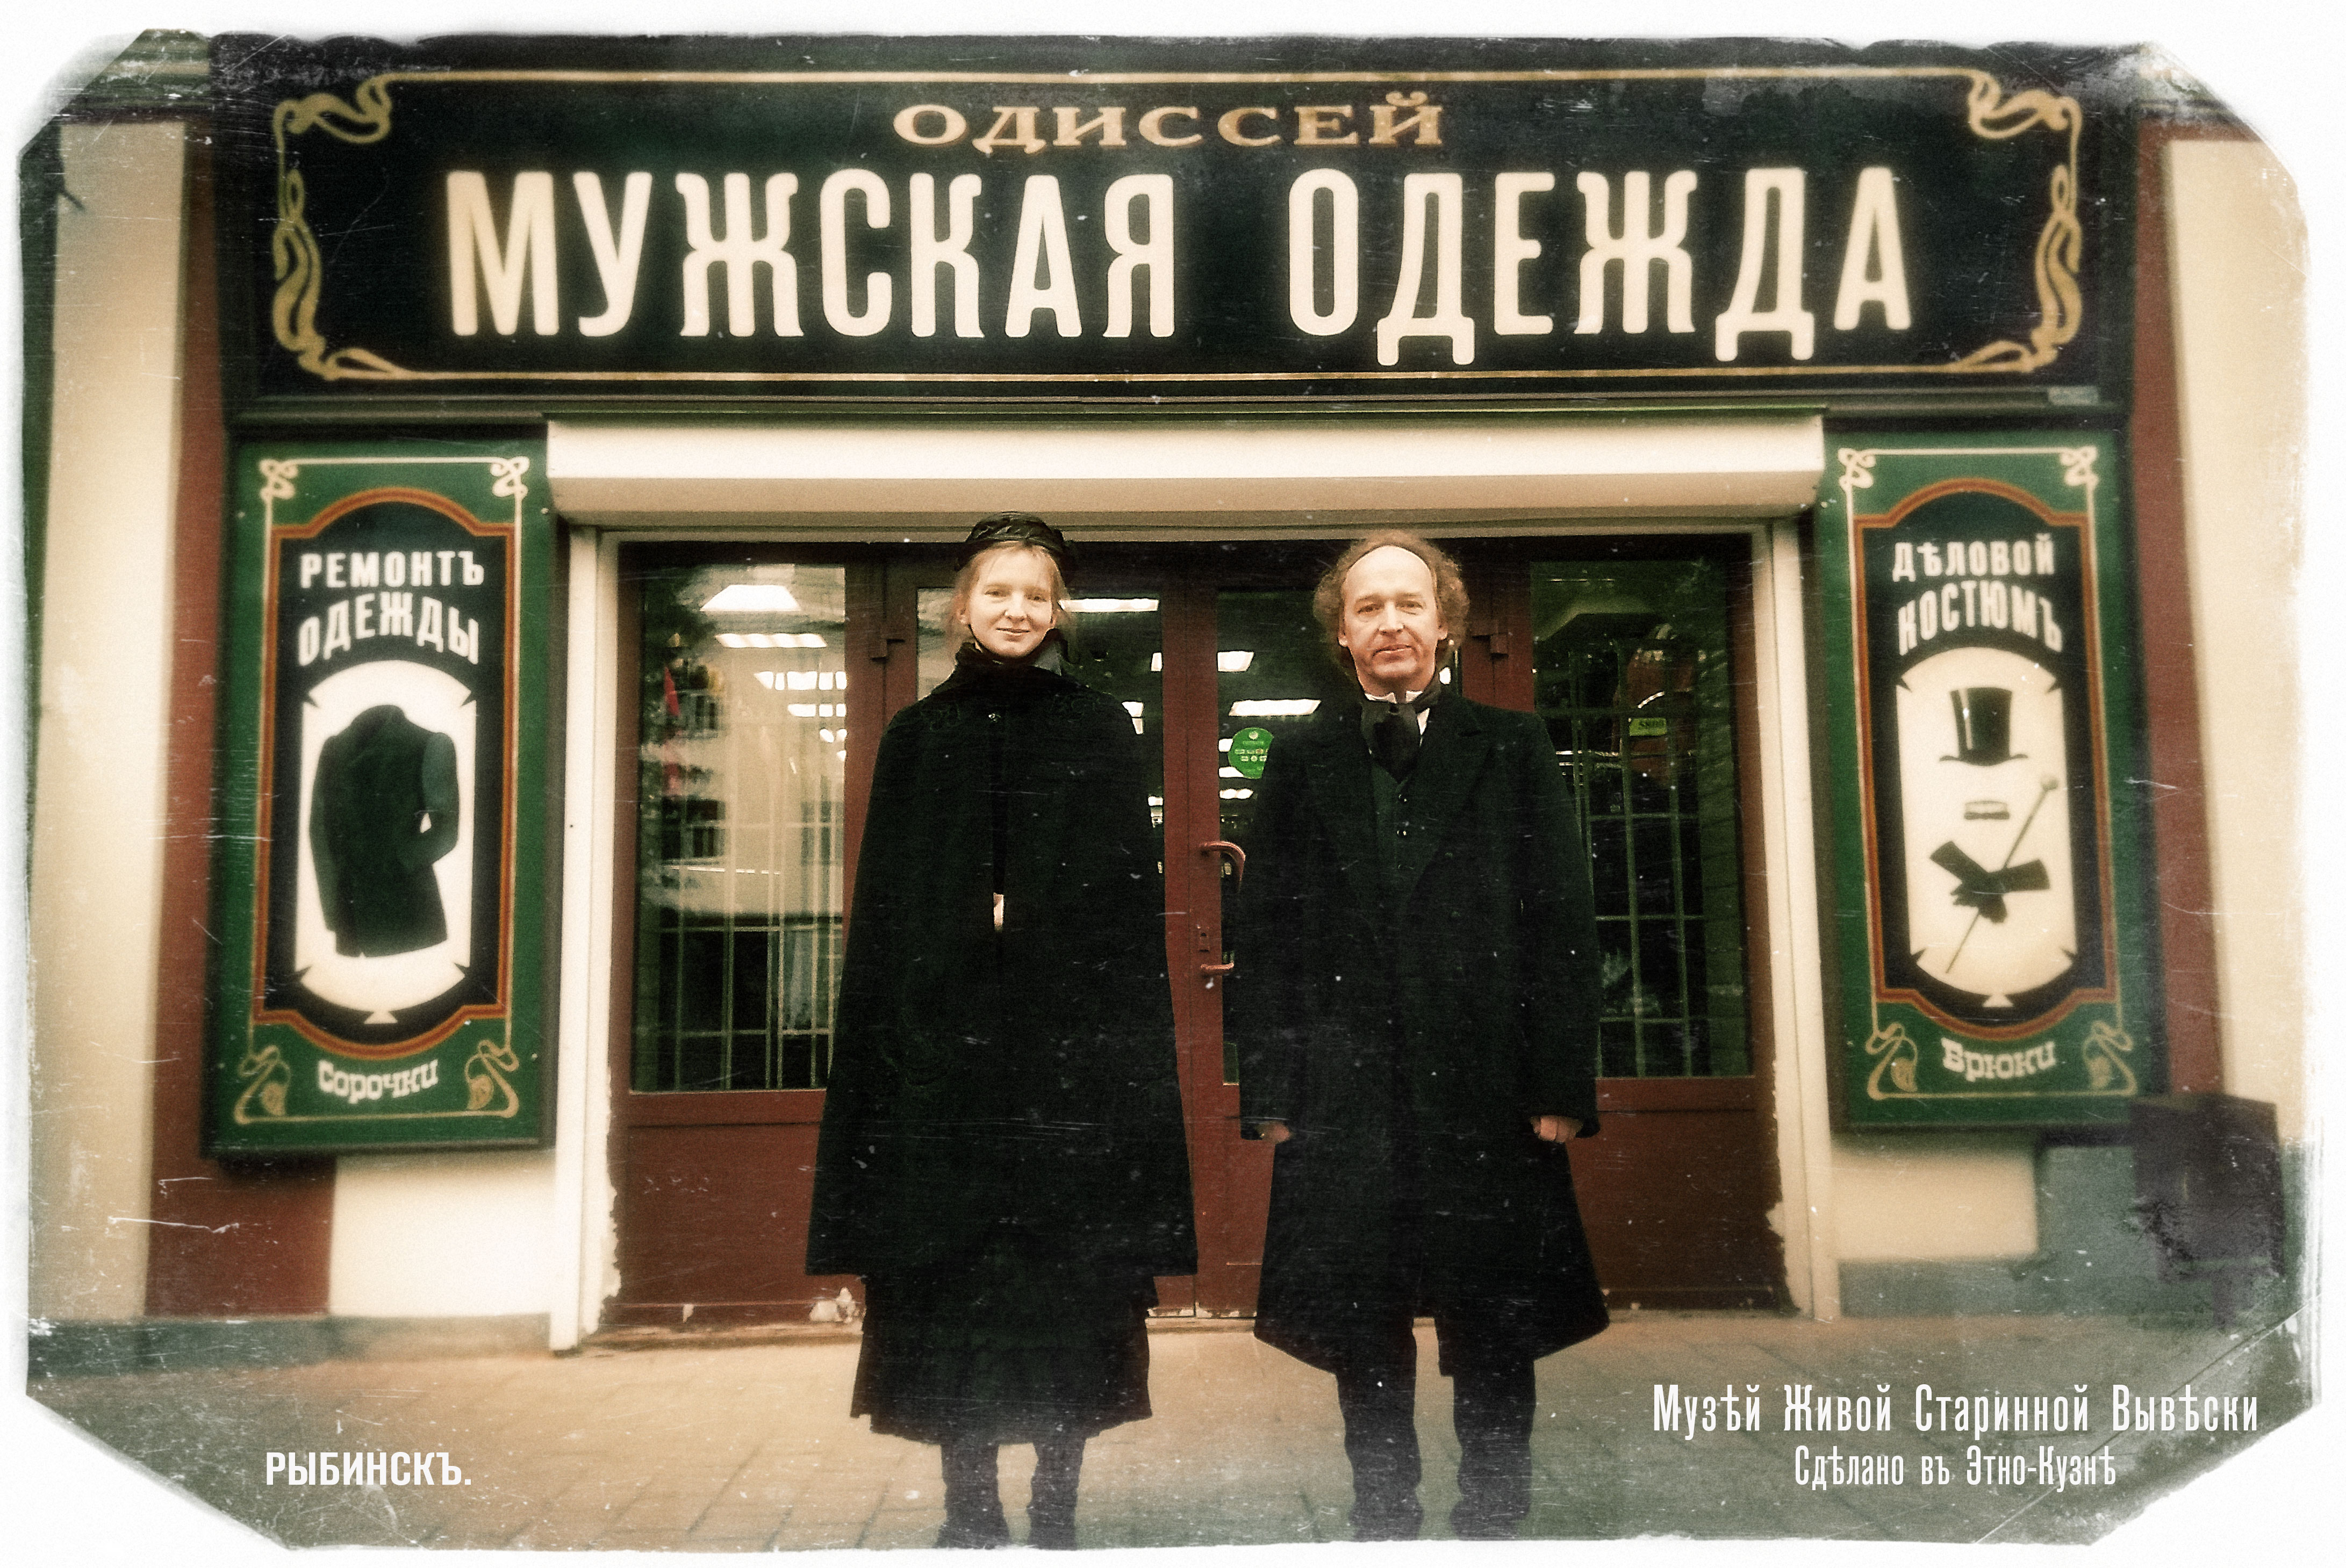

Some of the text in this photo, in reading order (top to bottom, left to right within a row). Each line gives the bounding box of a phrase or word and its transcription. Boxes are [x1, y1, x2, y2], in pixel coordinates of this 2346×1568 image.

[893, 92, 1443, 154] ОДИССЕЙ
[447, 167, 1911, 365] МУЖСКАЯ ОДЕЖДА
[300, 550, 484, 589] РЕМОНТЪ
[298, 591, 479, 667] ОДЕЖДЫ
[1898, 580, 2063, 657] КОСТЮМЪ
[318, 1059, 439, 1104] Сорочки
